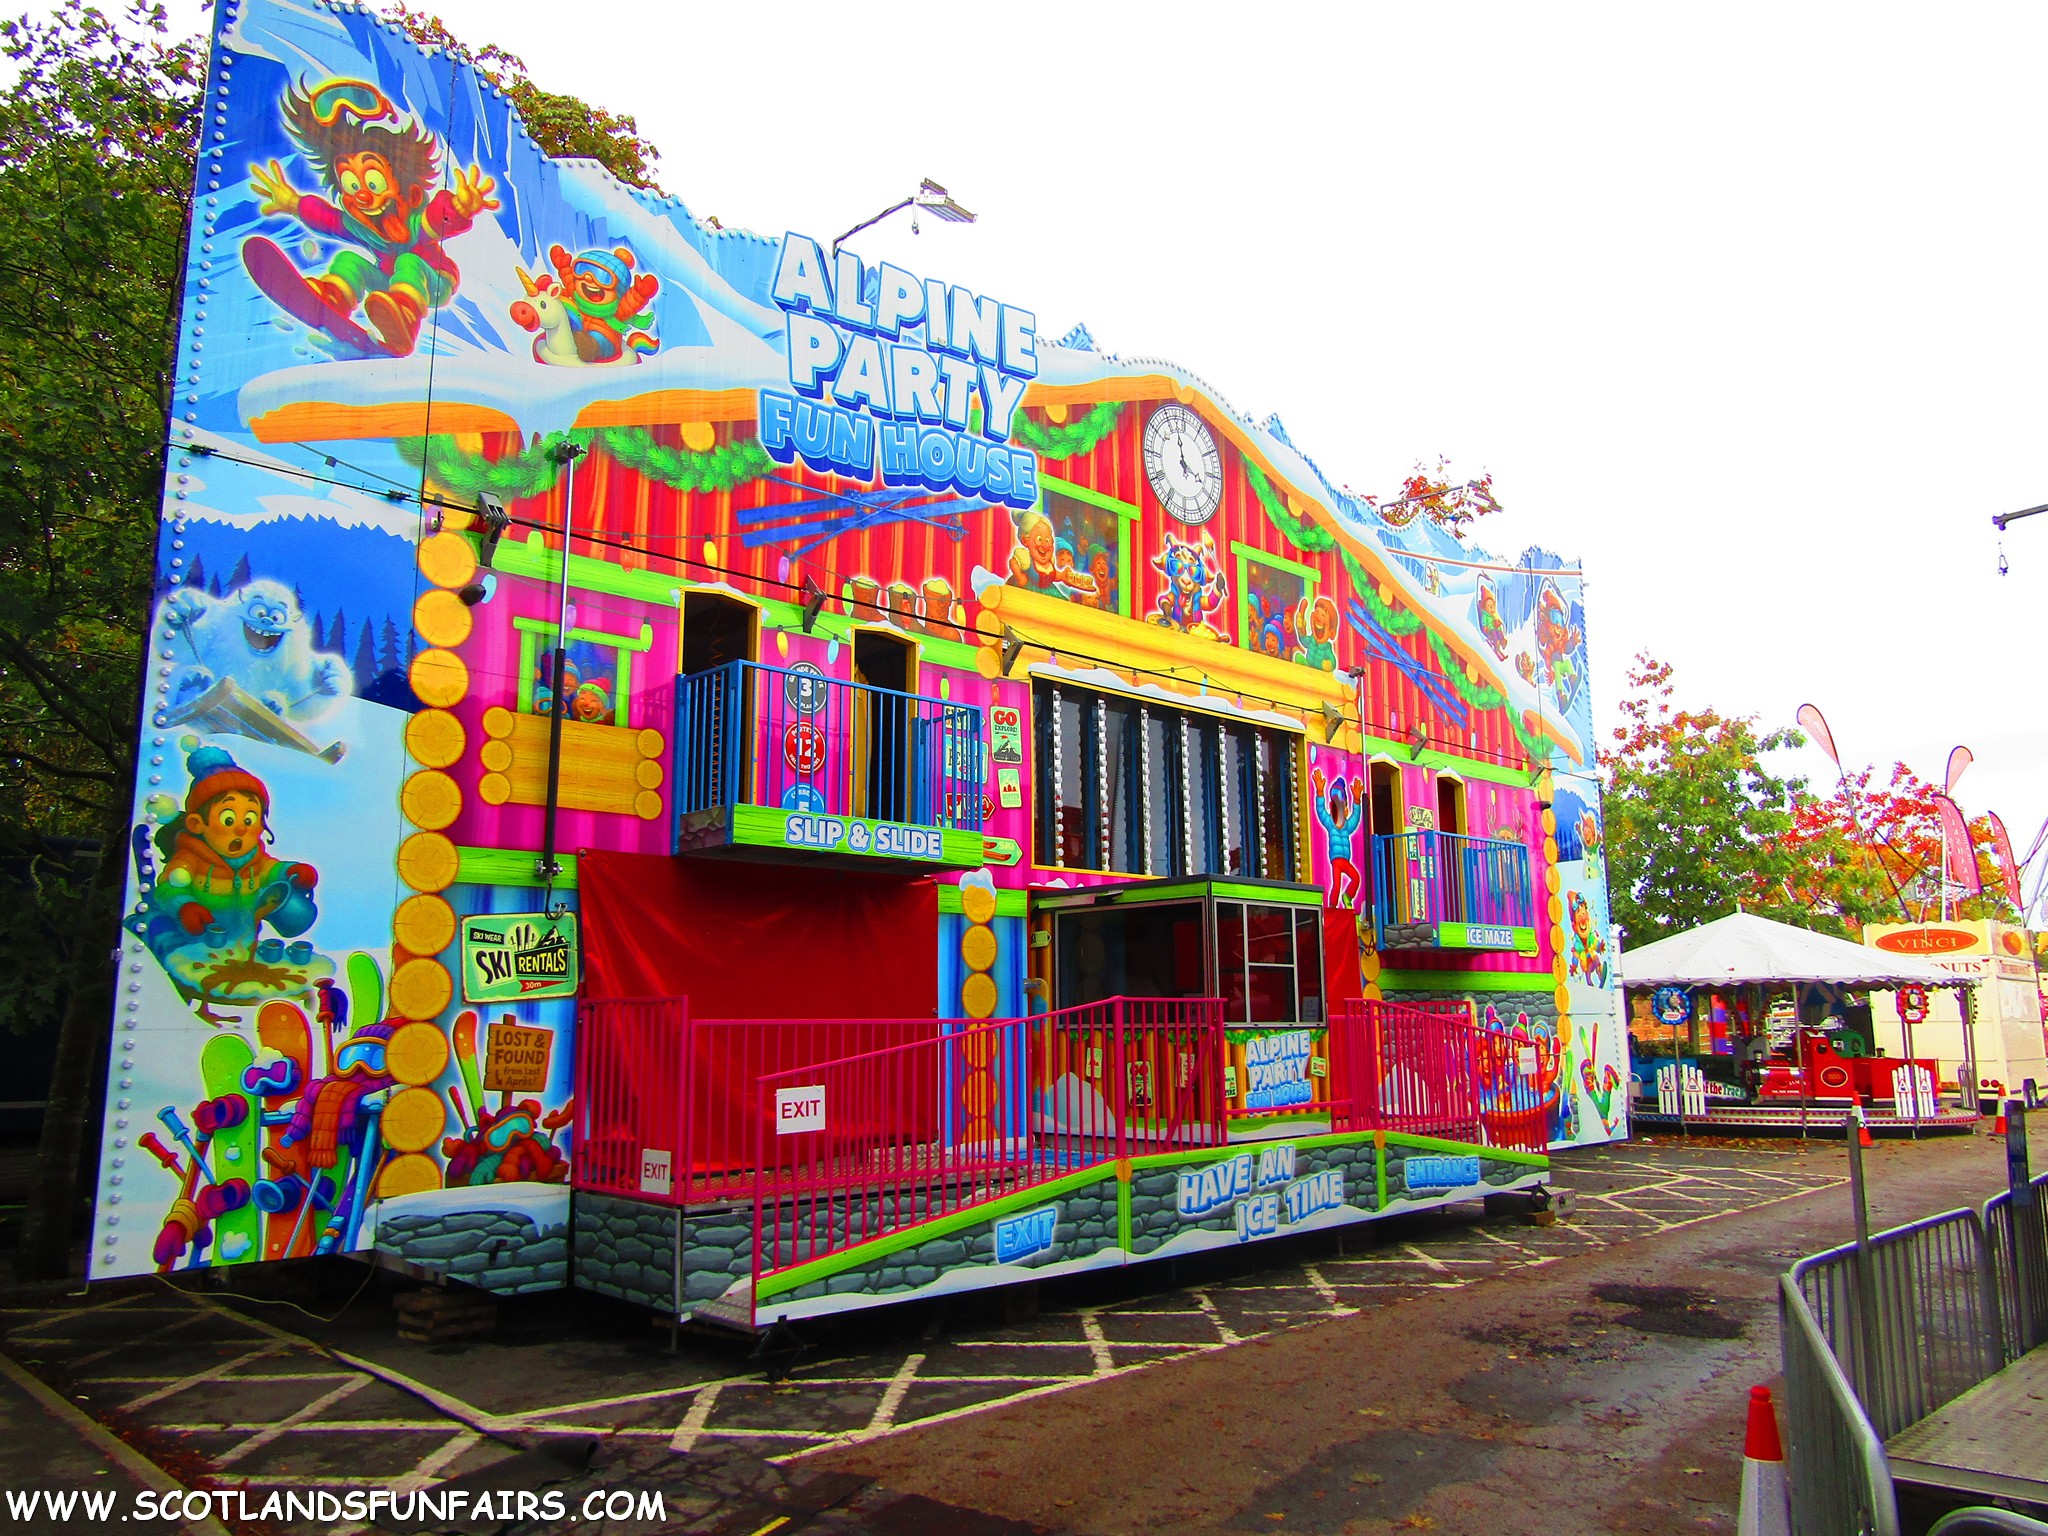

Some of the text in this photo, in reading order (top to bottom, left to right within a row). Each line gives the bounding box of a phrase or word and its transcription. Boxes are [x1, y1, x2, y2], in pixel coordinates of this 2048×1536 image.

[771, 231, 1038, 381] ALPINE
[786, 309, 1026, 443] PARTY
[760, 389, 1039, 508] FUN HOUSE
[801, 678, 813, 697] 3
[994, 710, 1017, 726] GO
[793, 738, 817, 758] 12
[787, 814, 944, 859] SLIP & SLIDE
[999, 842, 1014, 850] SKI
[473, 931, 503, 943] SKI WEAR
[1466, 927, 1513, 945] ICE MAZE
[1897, 937, 1957, 948] VINCI
[476, 950, 513, 984] SKI
[518, 948, 566, 973] RENTALS
[1930, 962, 1981, 973] NUTS
[525, 981, 542, 989] 30m
[495, 1030, 546, 1048] LOST &
[494, 1049, 545, 1065] FOUND
[1246, 1032, 1311, 1067] ALPINE
[503, 1066, 523, 1076] from
[1249, 1057, 1309, 1092] PARTY
[1246, 1080, 1312, 1109] FUN HOUSE
[1709, 1082, 1722, 1095] the
[781, 1099, 821, 1119] EXIT
[644, 1162, 668, 1180] EXIT
[1179, 1146, 1296, 1216] HAVE AN
[1405, 1156, 1481, 1190] ENTRANCE
[1236, 1172, 1344, 1243] ICE TIME
[995, 1208, 1057, 1265] EXIT
